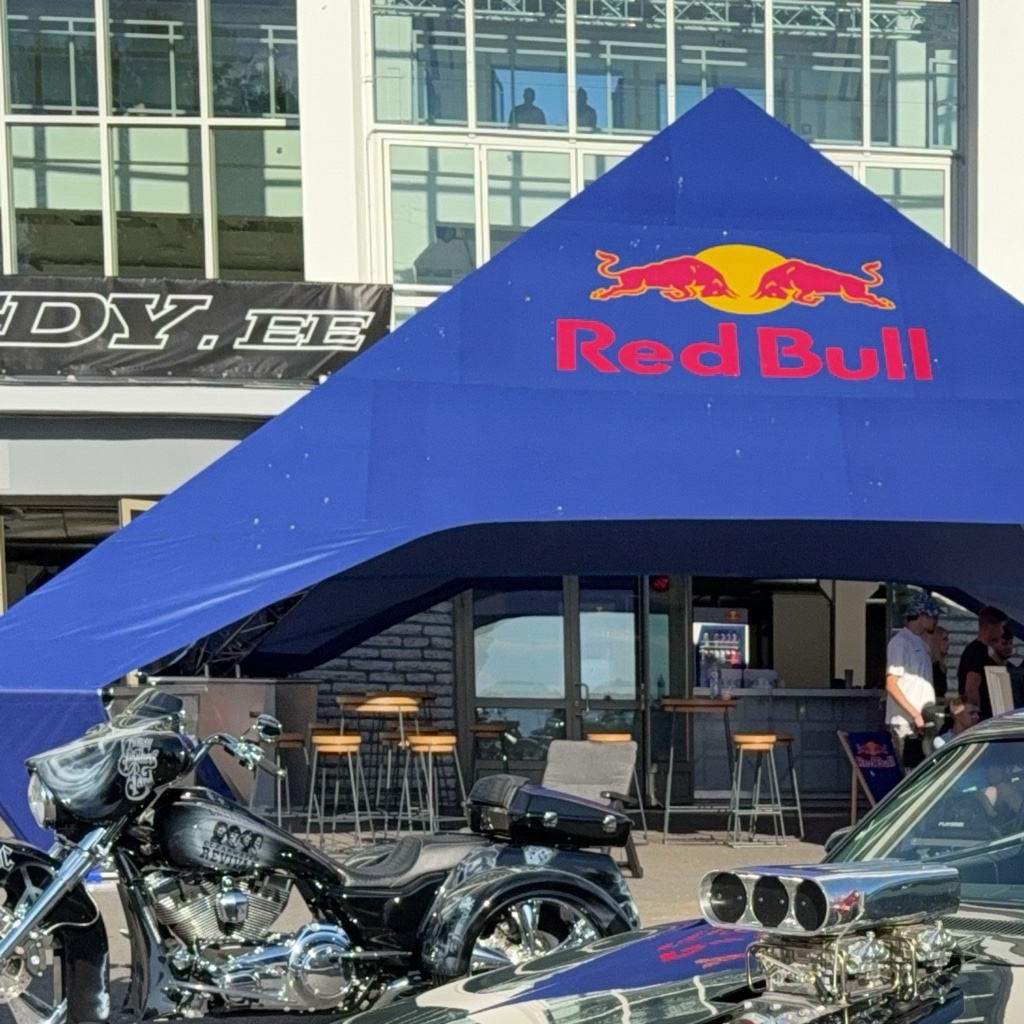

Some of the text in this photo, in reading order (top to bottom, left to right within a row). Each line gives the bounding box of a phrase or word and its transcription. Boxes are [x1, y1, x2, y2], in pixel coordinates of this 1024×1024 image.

[0, 291, 375, 351] DY.EE
[556, 318, 933, 381] Red Bull
